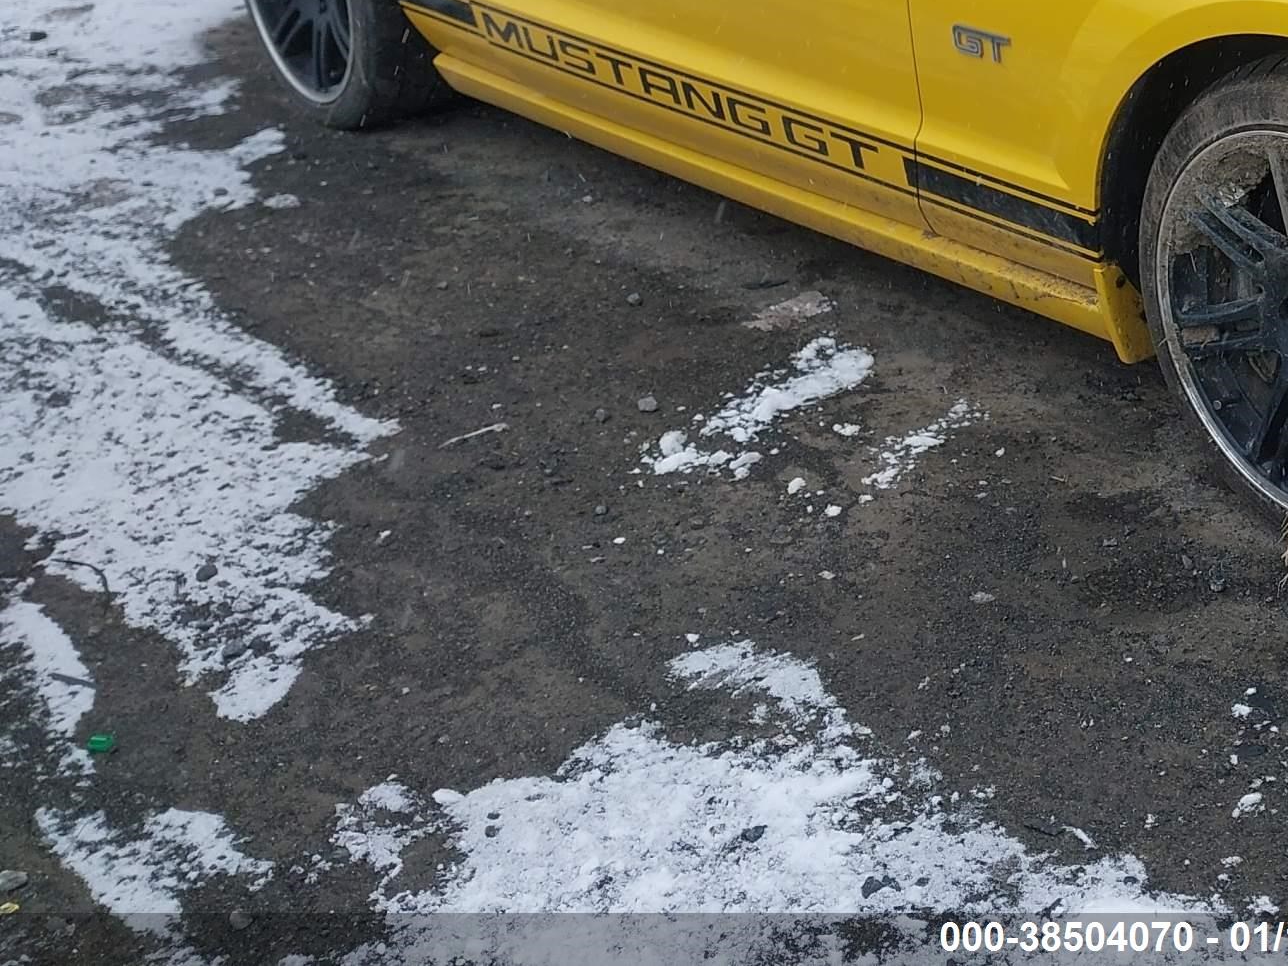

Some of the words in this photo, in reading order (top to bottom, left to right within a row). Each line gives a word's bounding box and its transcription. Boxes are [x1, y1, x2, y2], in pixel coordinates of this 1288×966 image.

[482, 12, 771, 135] MUSTANG
[784, 115, 878, 169] GT
[952, 24, 1011, 63] GT
